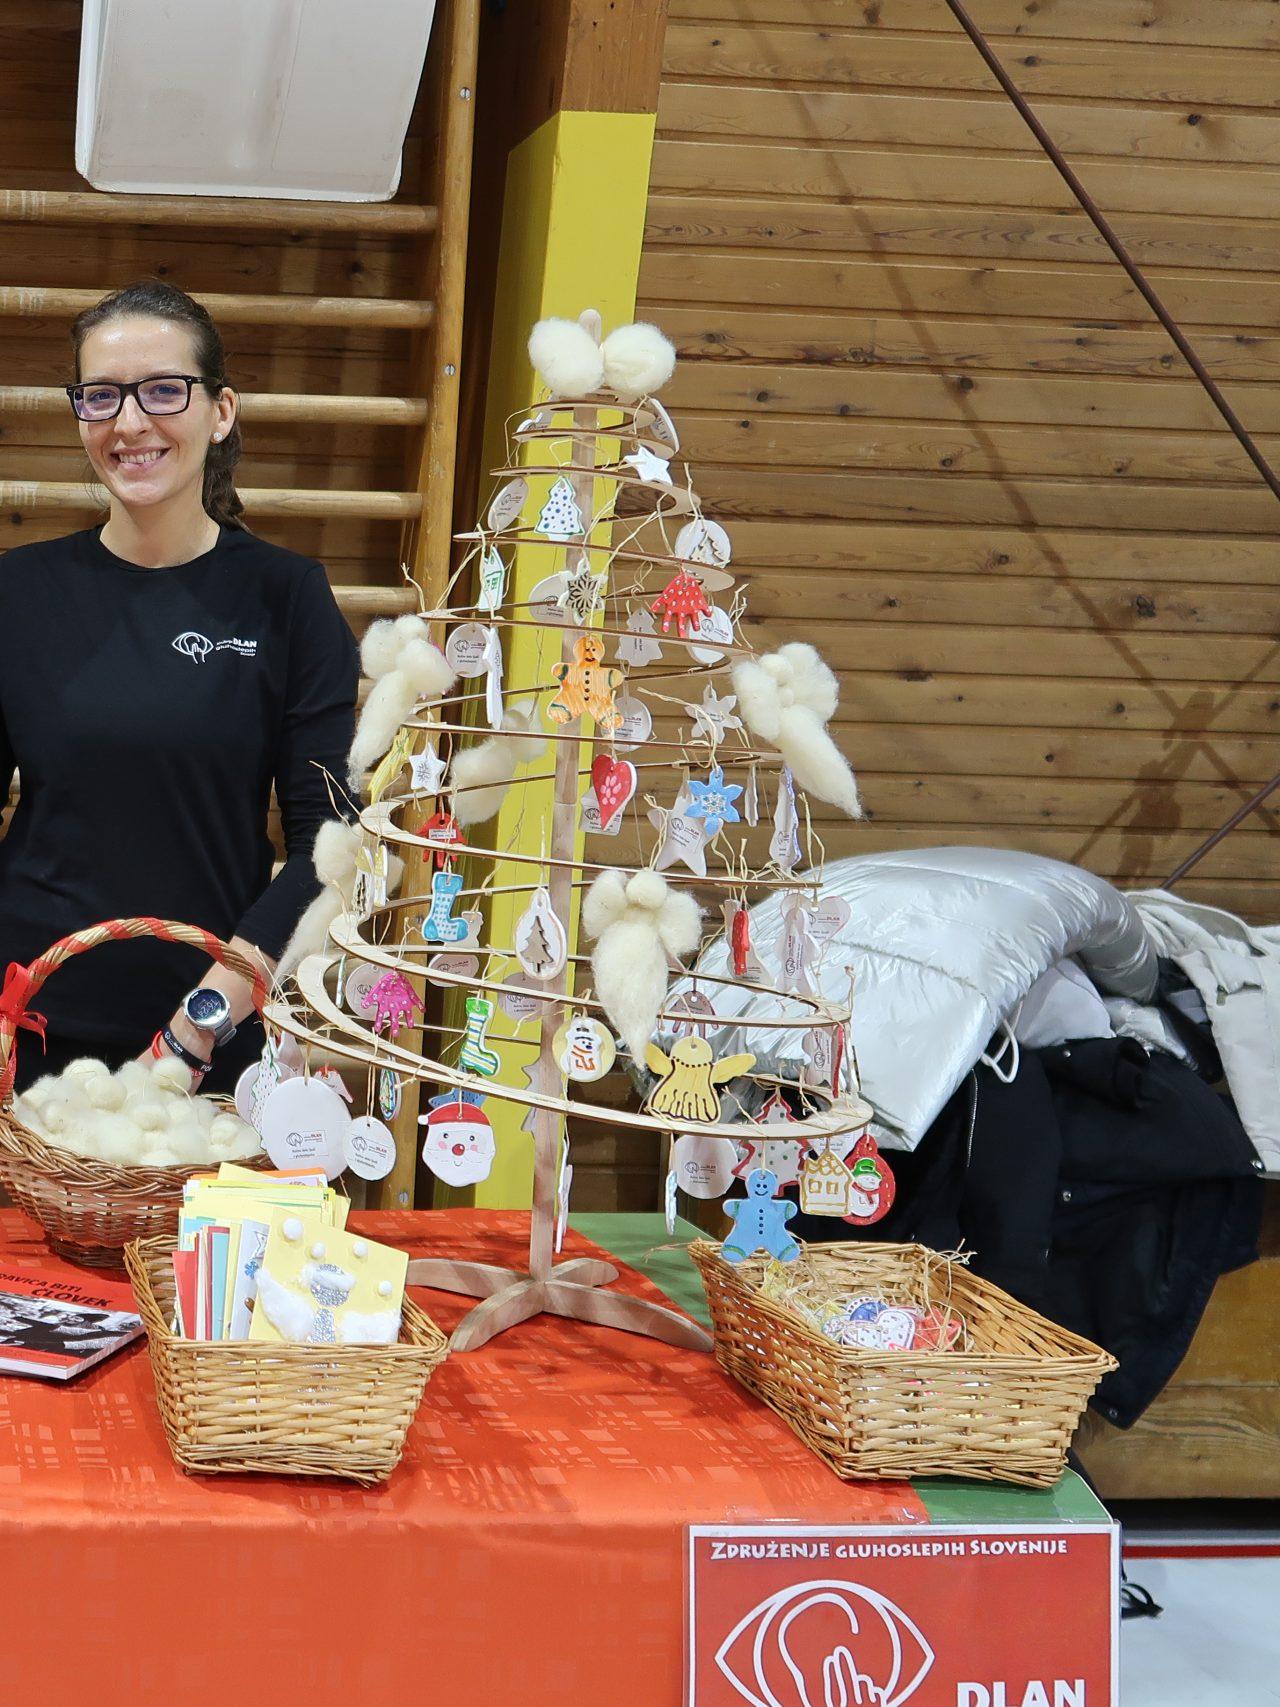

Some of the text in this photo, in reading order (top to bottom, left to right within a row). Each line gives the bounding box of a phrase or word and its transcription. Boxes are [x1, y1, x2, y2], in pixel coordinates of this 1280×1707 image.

[232, 637, 257, 648] DLAN
[49, 1282, 83, 1293] BITI
[957, 1679, 1086, 1707] DLAN
